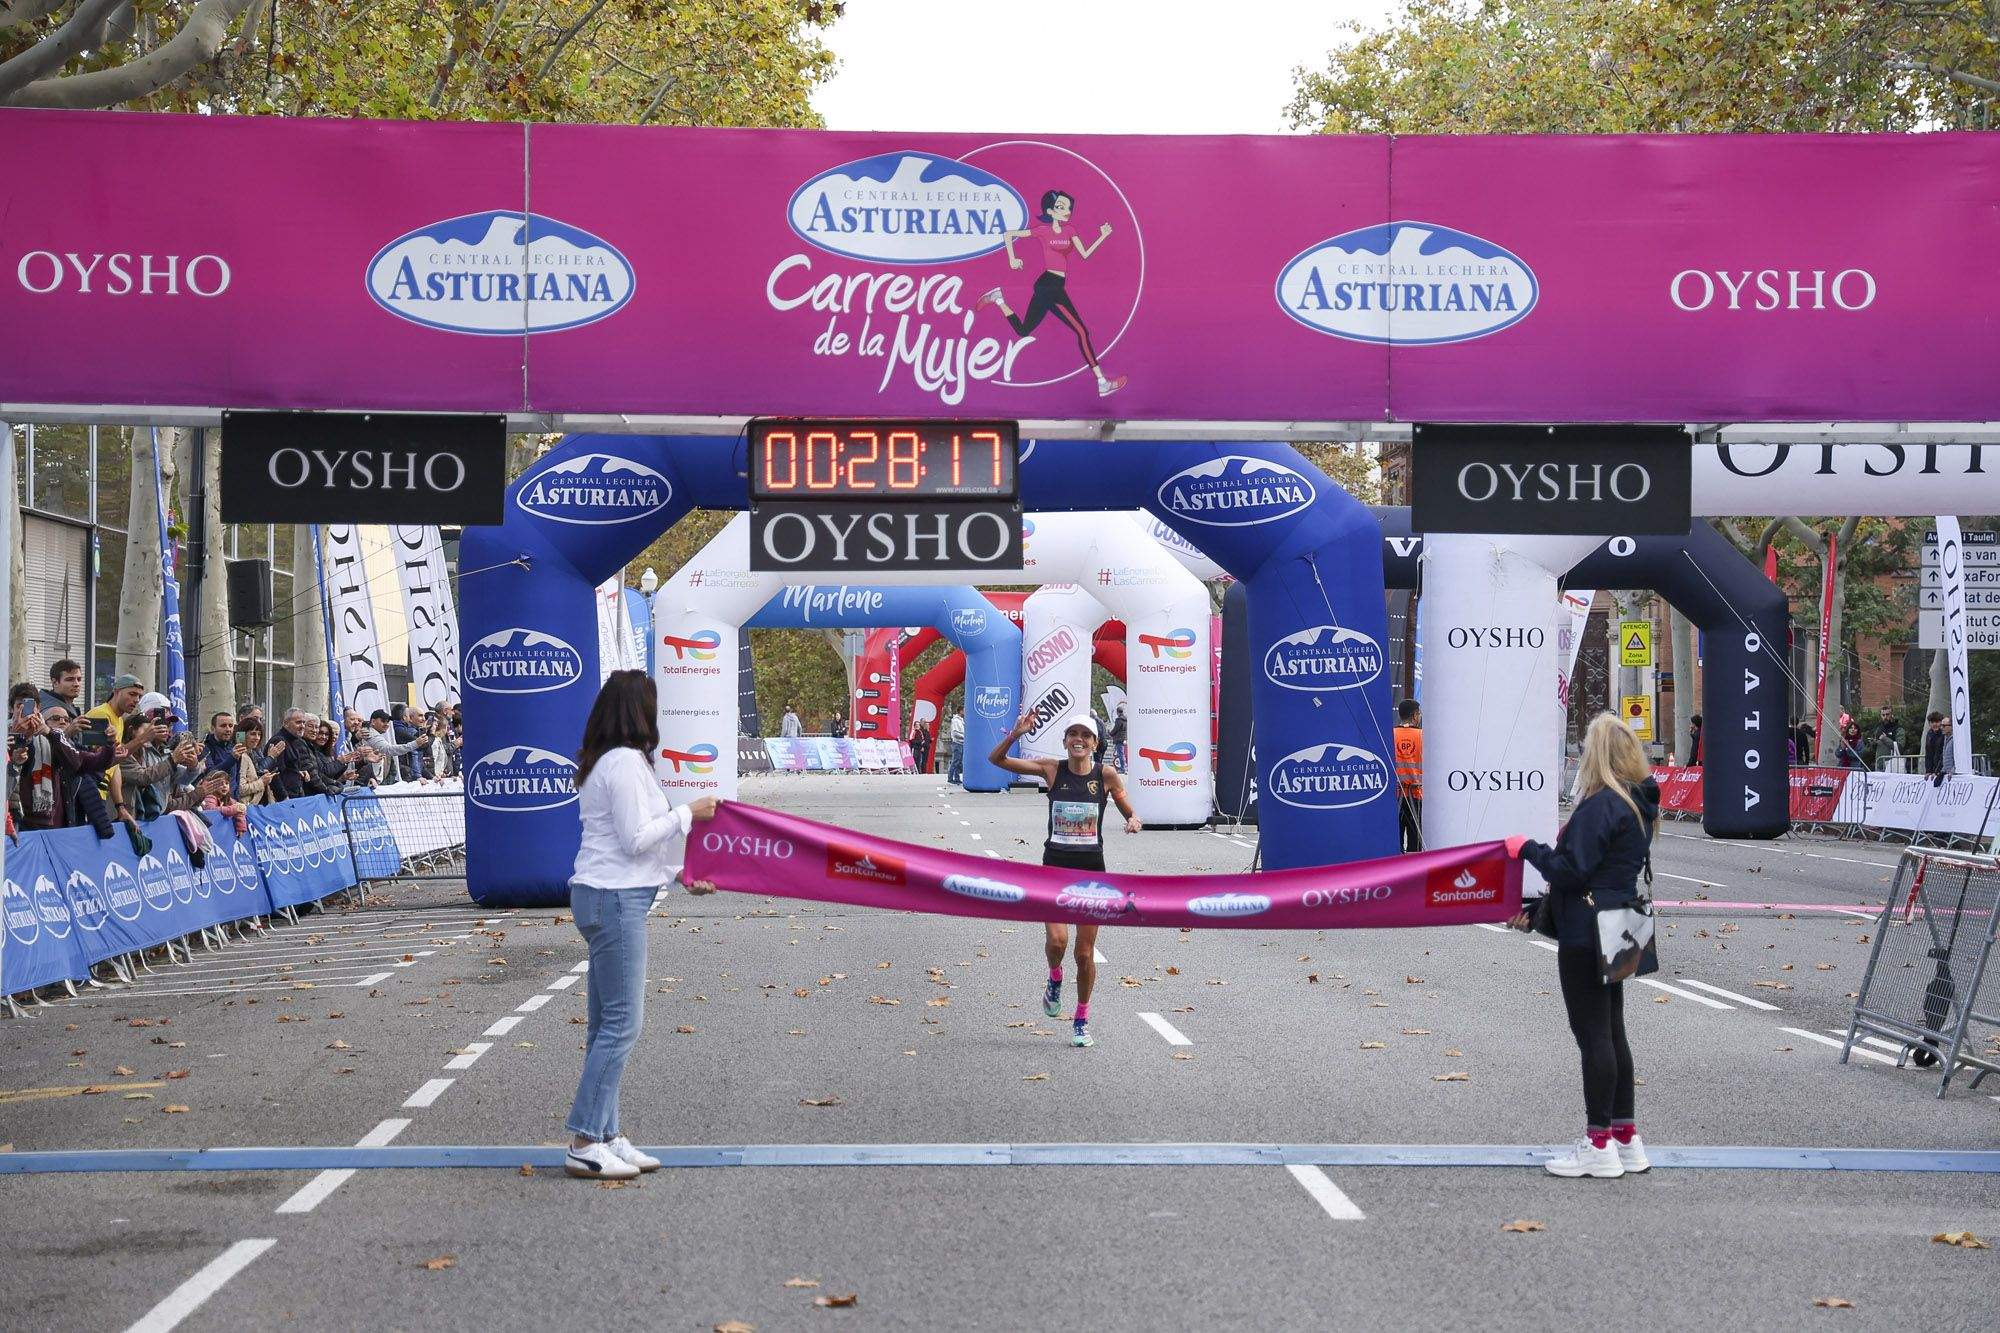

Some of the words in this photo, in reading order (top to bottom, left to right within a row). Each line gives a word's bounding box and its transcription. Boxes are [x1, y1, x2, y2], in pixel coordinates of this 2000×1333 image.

[844, 189, 918, 202] CENTRAL
[926, 191, 1002, 203] LECHERA
[806, 191, 1008, 236] ASTURIANA
[429, 253, 512, 266] CENTRAL
[521, 254, 606, 267] LECHERA
[1338, 263, 1420, 276] CENTRAL
[1426, 264, 1509, 276] LECHERA
[17, 250, 231, 297] OYSHO
[387, 255, 615, 302] ASTURIANA
[766, 253, 963, 315] Carrera
[1297, 265, 1518, 312] ASTURIANA
[1670, 269, 1877, 311] OYSHO
[813, 315, 851, 357] de
[858, 315, 885, 357] la
[878, 310, 1036, 406] Mujer
[268, 448, 466, 492] OYSHO
[552, 478, 601, 486] CENTRAL
[606, 478, 657, 486] LECHERA
[1190, 479, 1243, 491] CENTRAL
[1247, 476, 1298, 486] LECHERA
[1457, 462, 1651, 503] OYSHO
[526, 481, 660, 507] ASTURIANA
[1172, 486, 1306, 512] ASTURIANA
[763, 512, 1010, 563] OYSHO
[1153, 521, 1202, 554] COS
[1968, 533, 1994, 541] Taulet
[1976, 552, 1997, 560] van
[783, 584, 883, 623] Marlene
[1448, 627, 1544, 649] OYSHO
[483, 651, 524, 659] CENTRAL
[527, 650, 571, 658] LECHERA
[1027, 630, 1074, 676] COSMO
[1288, 647, 1333, 656] CENTRAL
[1336, 646, 1375, 654] LECHERA
[469, 655, 575, 680] ASTURIANA
[663, 666, 721, 676] TotalEnergies
[1138, 664, 1197, 675] TotalEnergies
[1271, 652, 1378, 677] ASTURIANA
[662, 709, 720, 718] totalenergies.es
[1138, 706, 1197, 716] totalenergies.es
[1744, 632, 1761, 812] VOLVO
[485, 768, 526, 776] CENTRAL
[530, 767, 574, 776] LECHERA
[1293, 764, 1337, 774] CENTRAL
[1340, 763, 1380, 772] LECHERA
[472, 772, 578, 797] ASTURIANA
[661, 779, 718, 789] TotalEnergies
[1138, 778, 1198, 788] TotalEnergies
[1276, 769, 1384, 794] ASTURIANA
[1447, 770, 1544, 792] OYSHO
[703, 832, 794, 859] OYSHO
[834, 862, 897, 881] Santander
[950, 880, 1018, 901] ASTURIANA
[1302, 885, 1392, 907] OYSHO
[1433, 888, 1496, 902] Santander
